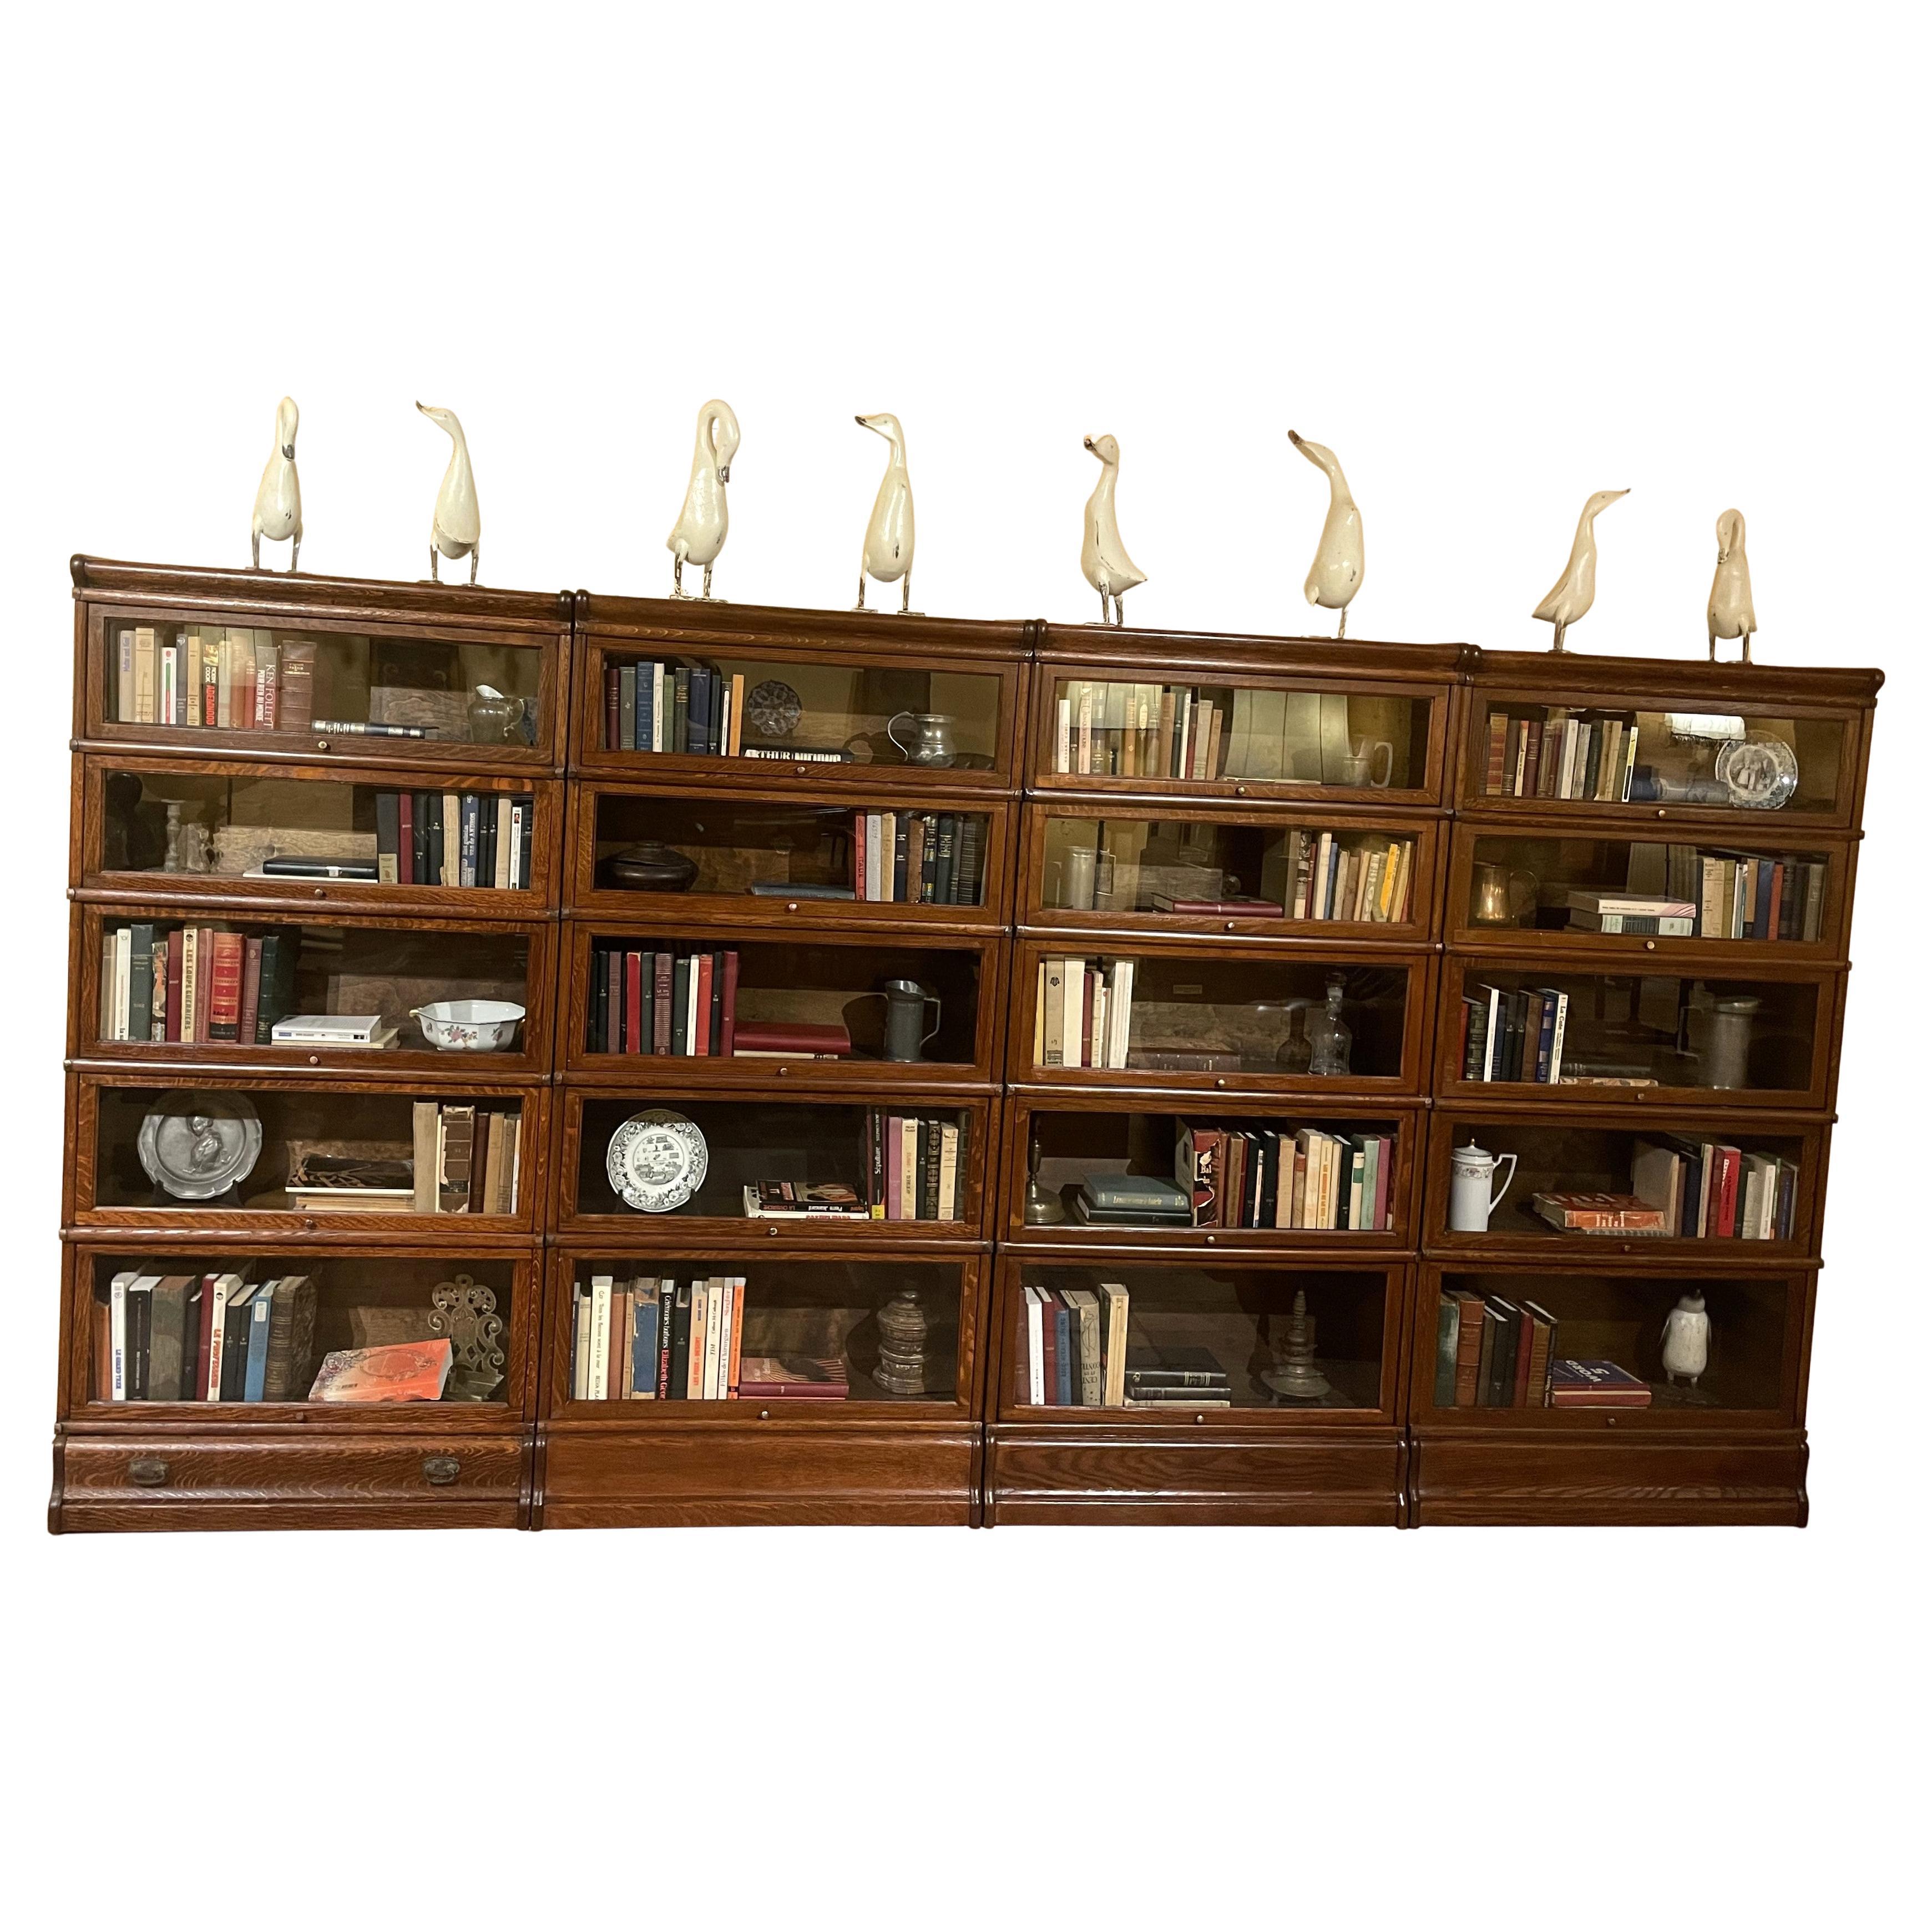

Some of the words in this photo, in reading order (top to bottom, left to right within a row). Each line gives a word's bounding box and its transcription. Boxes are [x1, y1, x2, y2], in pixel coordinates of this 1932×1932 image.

[266, 664, 276, 685] KEN
[264, 688, 275, 729] FOLLETT
[744, 749, 791, 760] ARTHUR
[661, 1349, 670, 1381] Elizabeth
[1565, 1359, 1602, 1383] WORD
